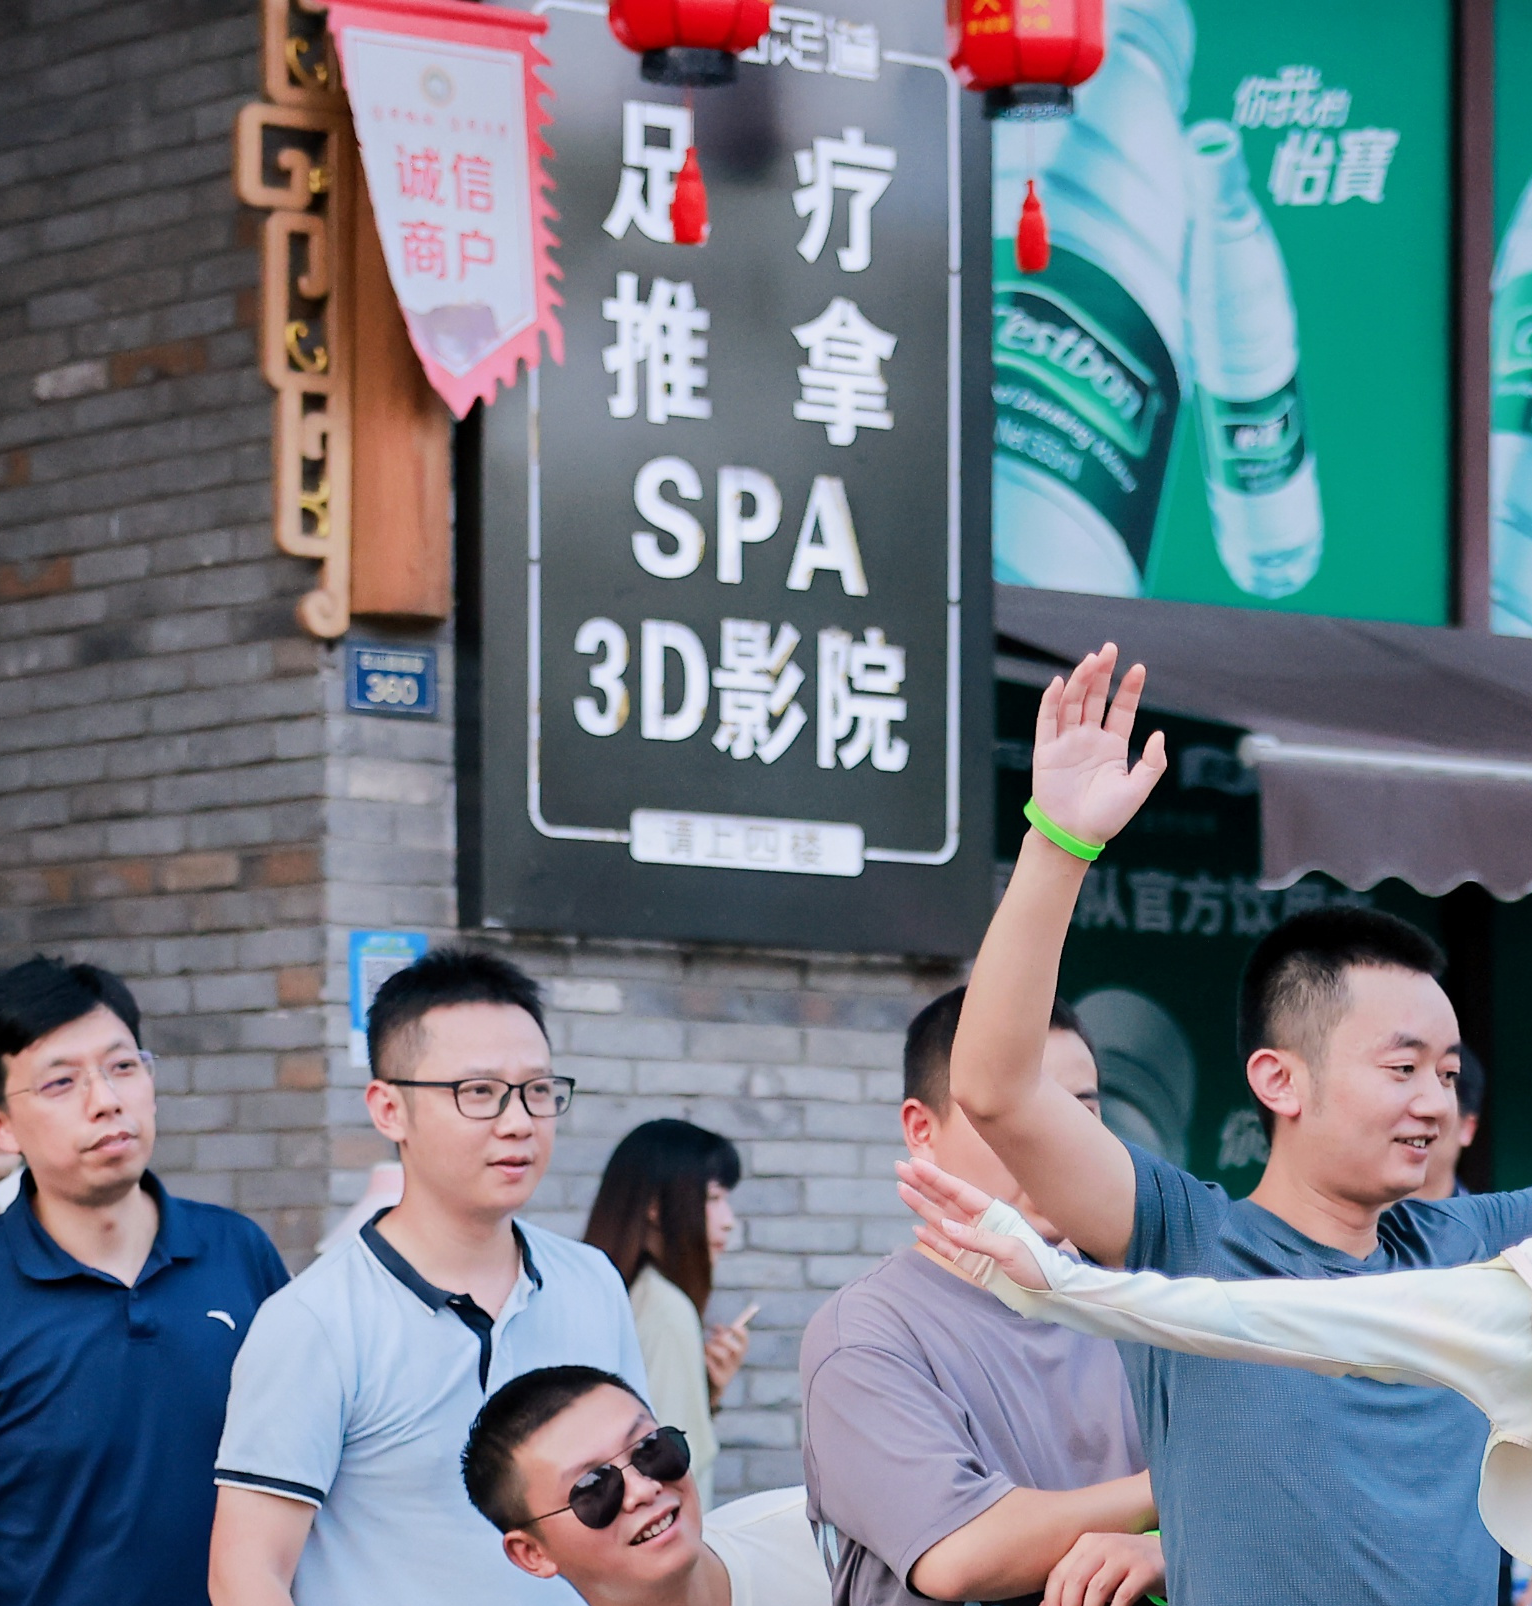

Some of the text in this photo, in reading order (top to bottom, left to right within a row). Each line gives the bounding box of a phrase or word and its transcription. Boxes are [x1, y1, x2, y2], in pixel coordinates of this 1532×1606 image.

[394, 144, 494, 213] 诚信
[398, 219, 495, 281] 商户
[601, 270, 899, 447] 推拿
[630, 455, 869, 598] SPA
[573, 616, 910, 774] 3D影院
